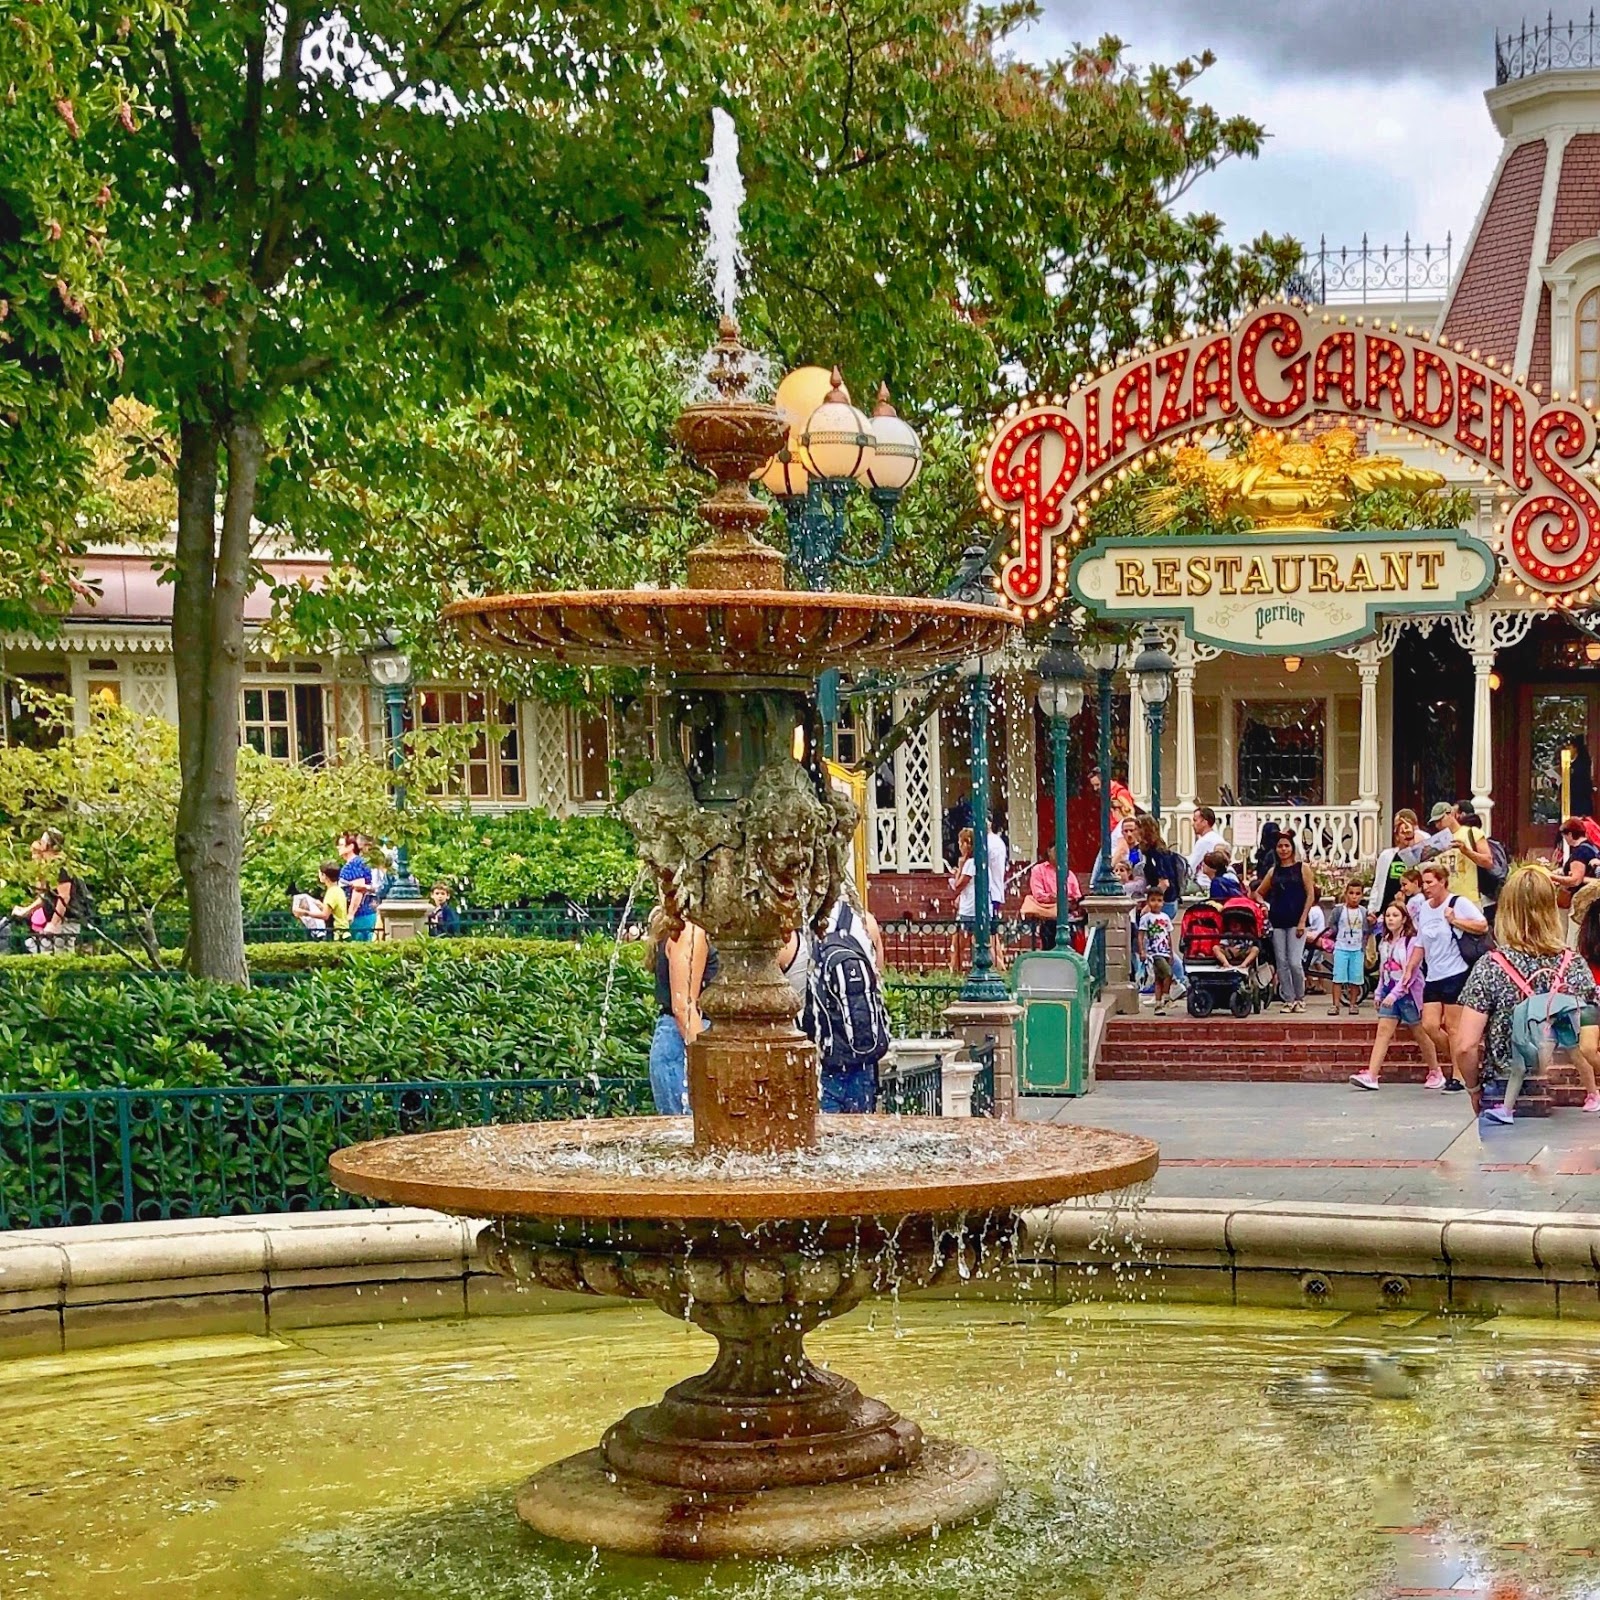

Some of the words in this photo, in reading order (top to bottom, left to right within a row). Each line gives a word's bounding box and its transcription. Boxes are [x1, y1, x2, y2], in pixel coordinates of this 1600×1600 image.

[991, 336, 1238, 598] PLAZA
[1237, 311, 1600, 584] GARDENS
[1115, 550, 1445, 597] RESTAURANT
